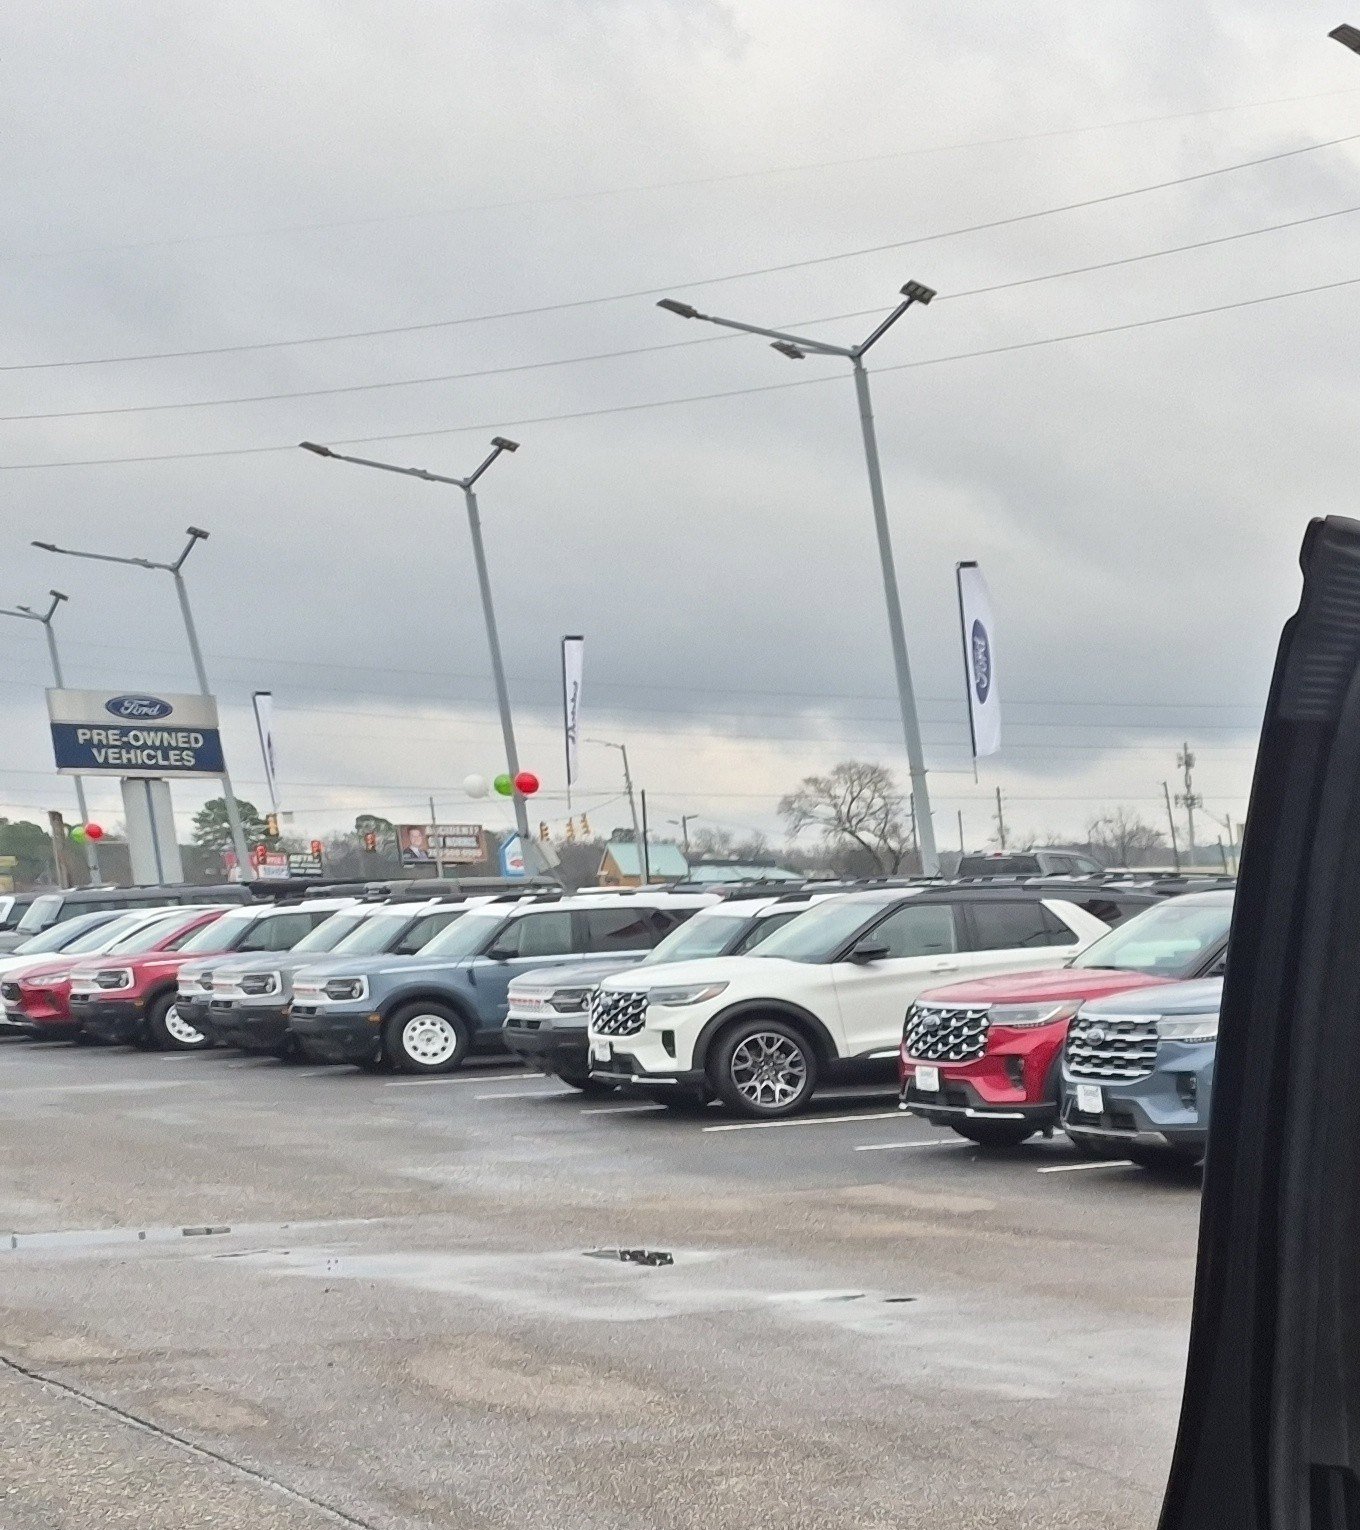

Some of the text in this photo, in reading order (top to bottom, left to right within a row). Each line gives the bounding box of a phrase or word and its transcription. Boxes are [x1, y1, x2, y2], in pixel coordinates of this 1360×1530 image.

[120, 700, 161, 716] Ford
[76, 728, 204, 748] PRE-OWNED
[91, 748, 196, 767] VEHICLES
